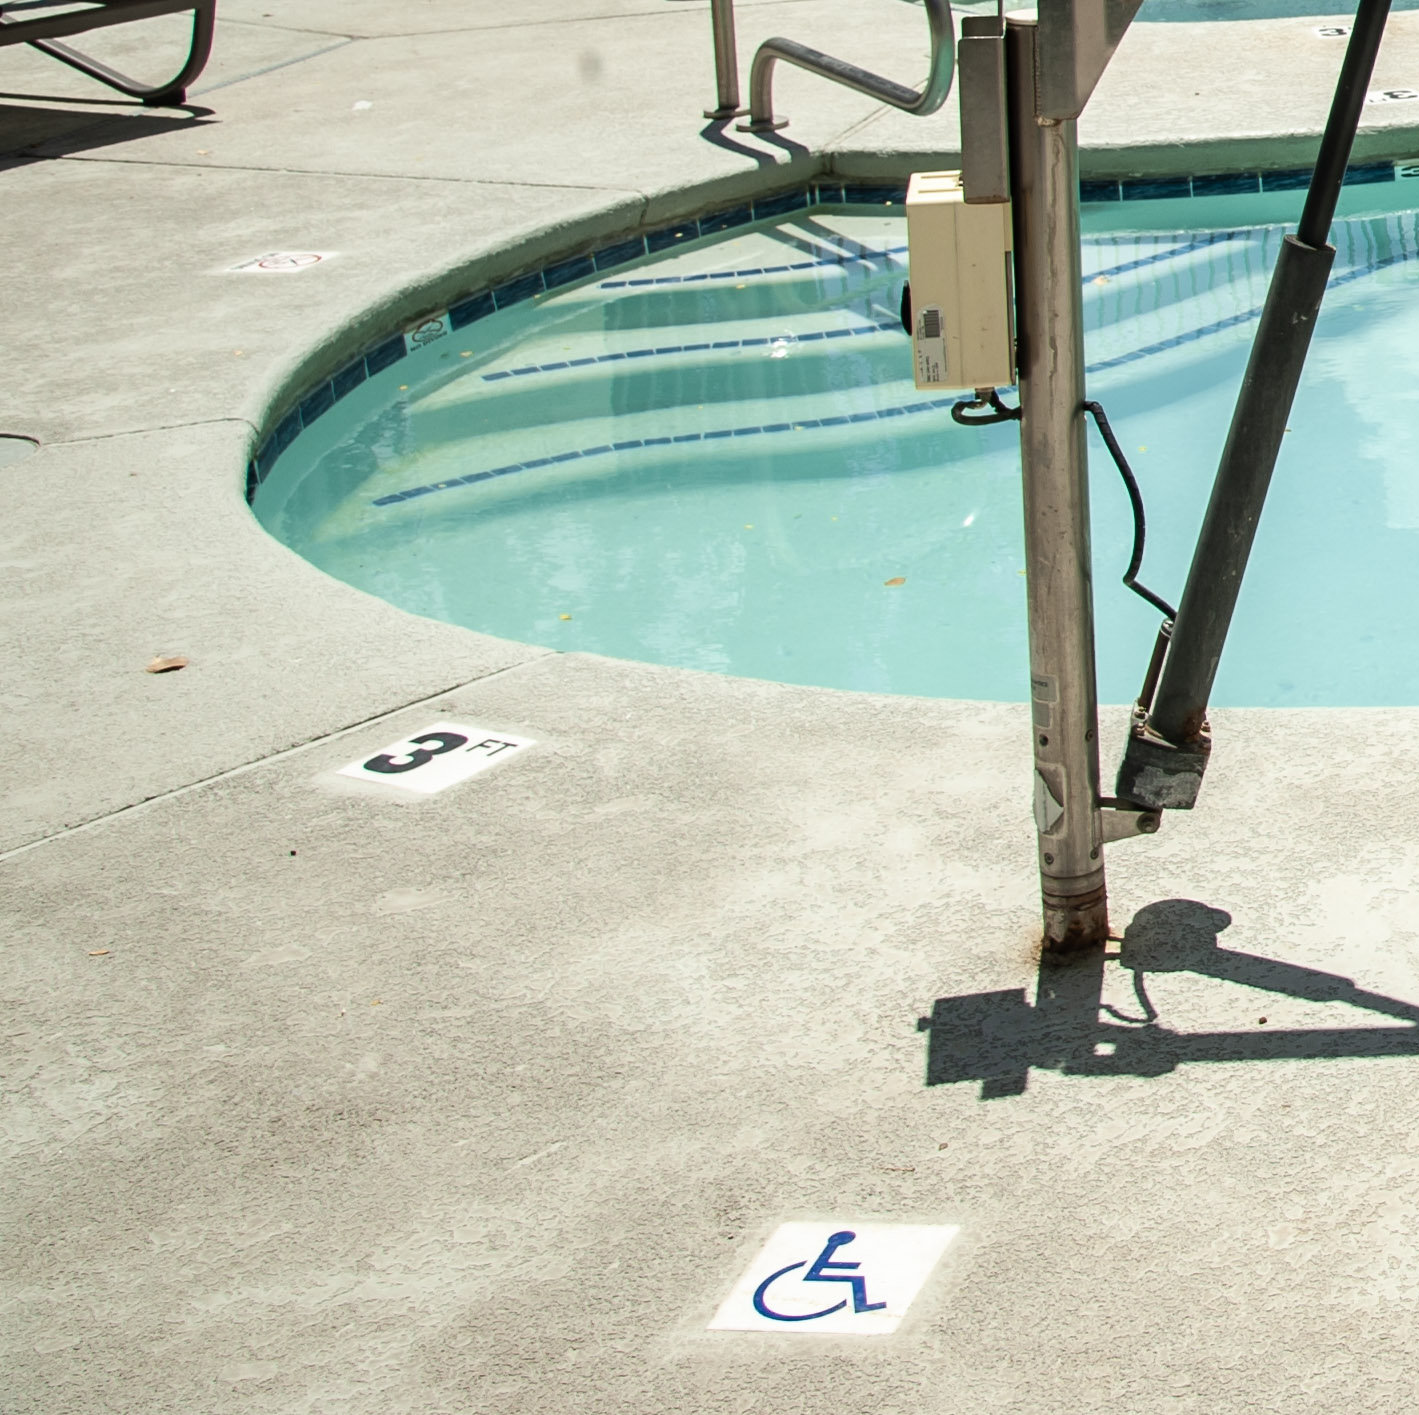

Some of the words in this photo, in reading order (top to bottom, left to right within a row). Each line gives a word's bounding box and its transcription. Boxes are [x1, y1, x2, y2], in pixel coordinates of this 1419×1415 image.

[1319, 28, 1347, 36] 3
[1383, 90, 1418, 99] 3
[363, 732, 469, 774] 3
[466, 739, 519, 756] FT
